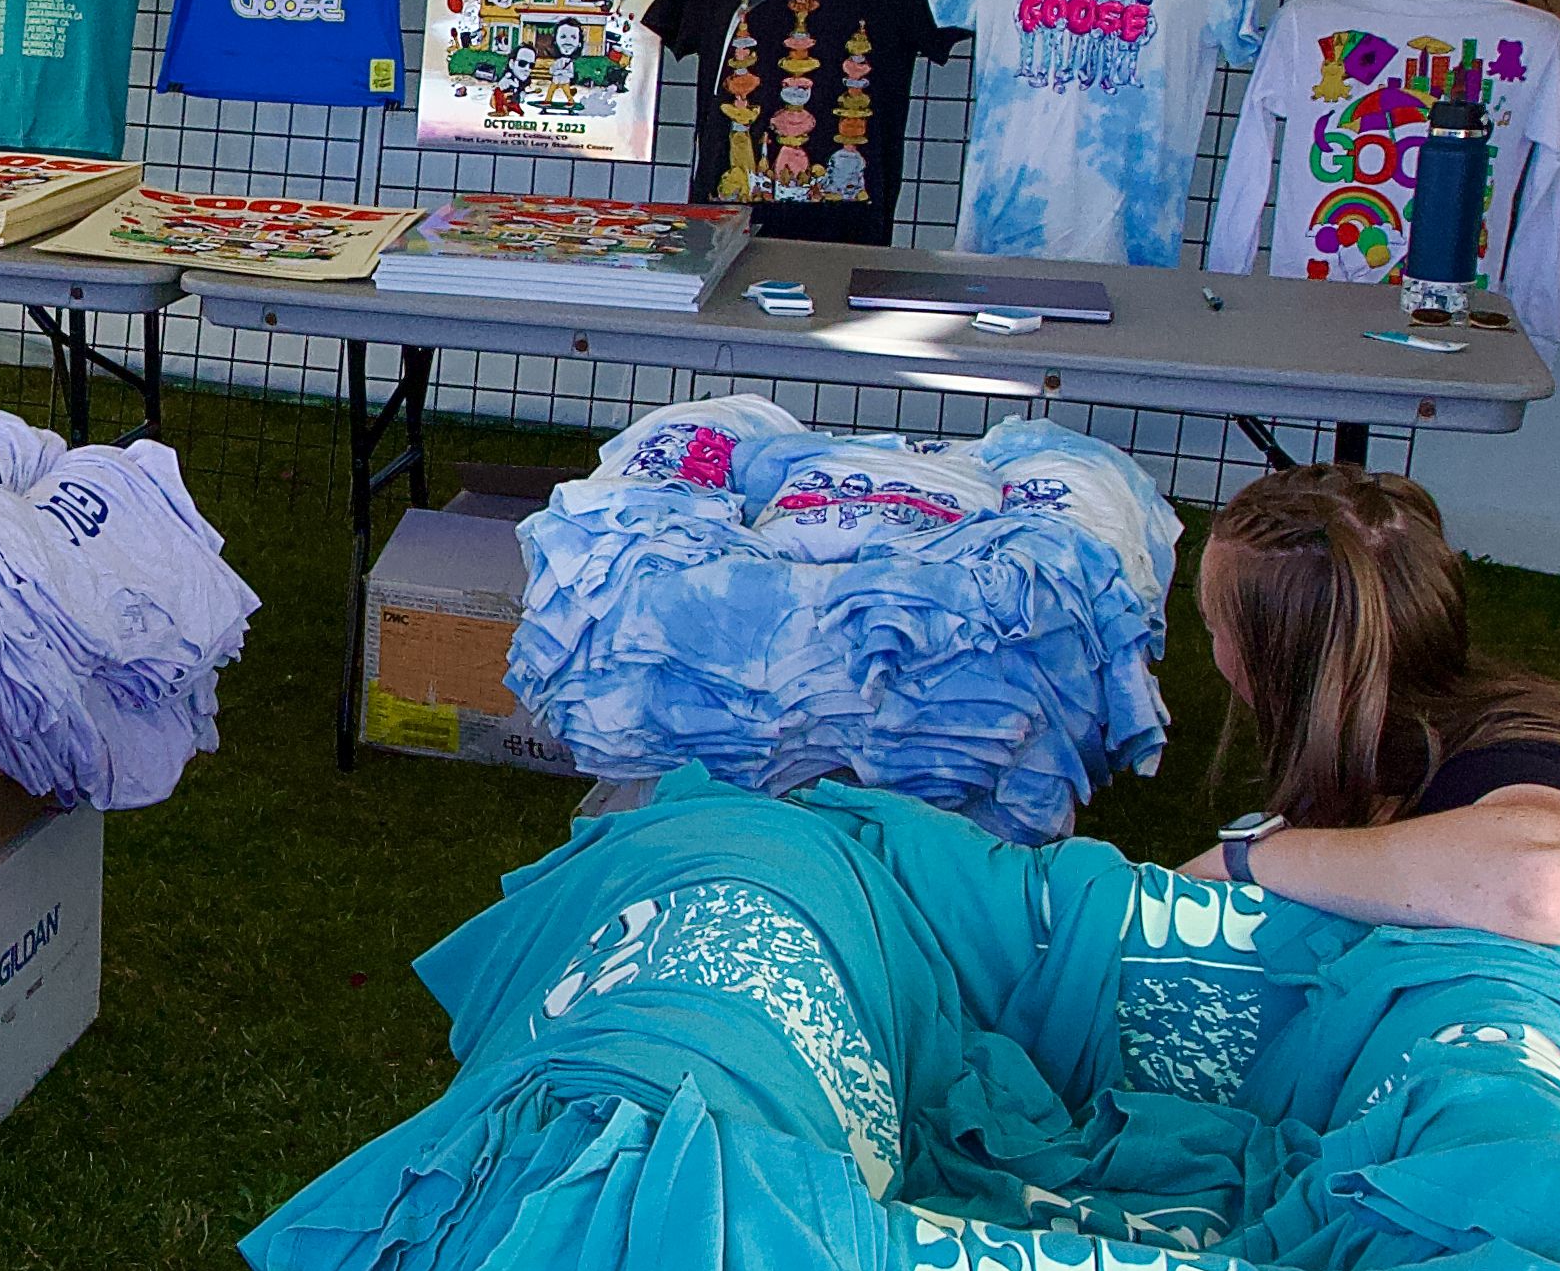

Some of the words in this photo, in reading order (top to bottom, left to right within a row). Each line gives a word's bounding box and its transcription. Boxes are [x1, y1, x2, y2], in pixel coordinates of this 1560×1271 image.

[484, 119, 537, 131] OCTOBER
[556, 123, 586, 134] 2023
[139, 188, 418, 222] GOOSE
